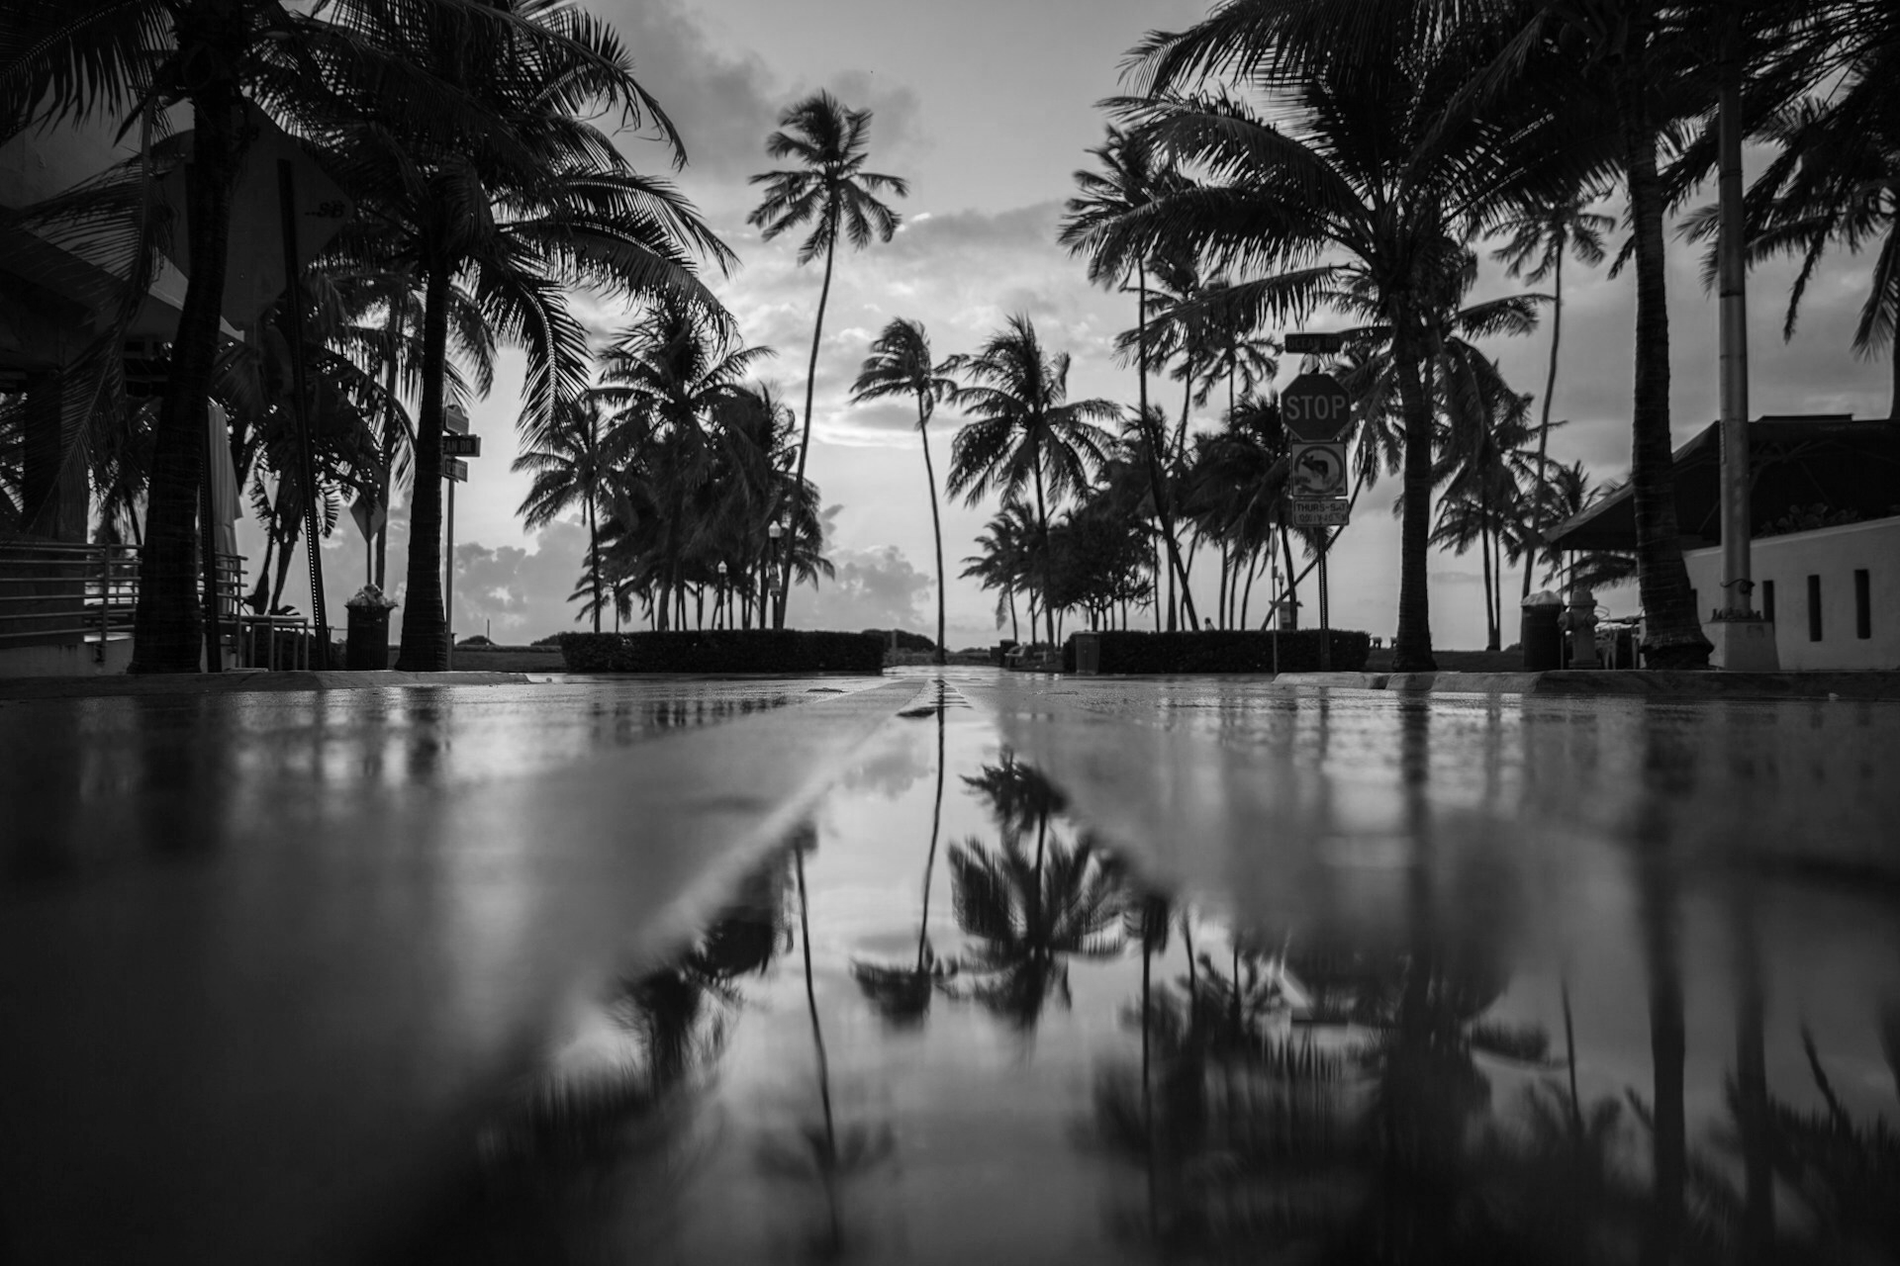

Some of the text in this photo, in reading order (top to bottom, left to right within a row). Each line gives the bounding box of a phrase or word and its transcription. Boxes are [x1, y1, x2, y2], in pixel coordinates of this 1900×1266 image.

[1287, 338, 1338, 349] OCEAN DR
[1286, 395, 1346, 420] STOP
[460, 440, 472, 452] DR
